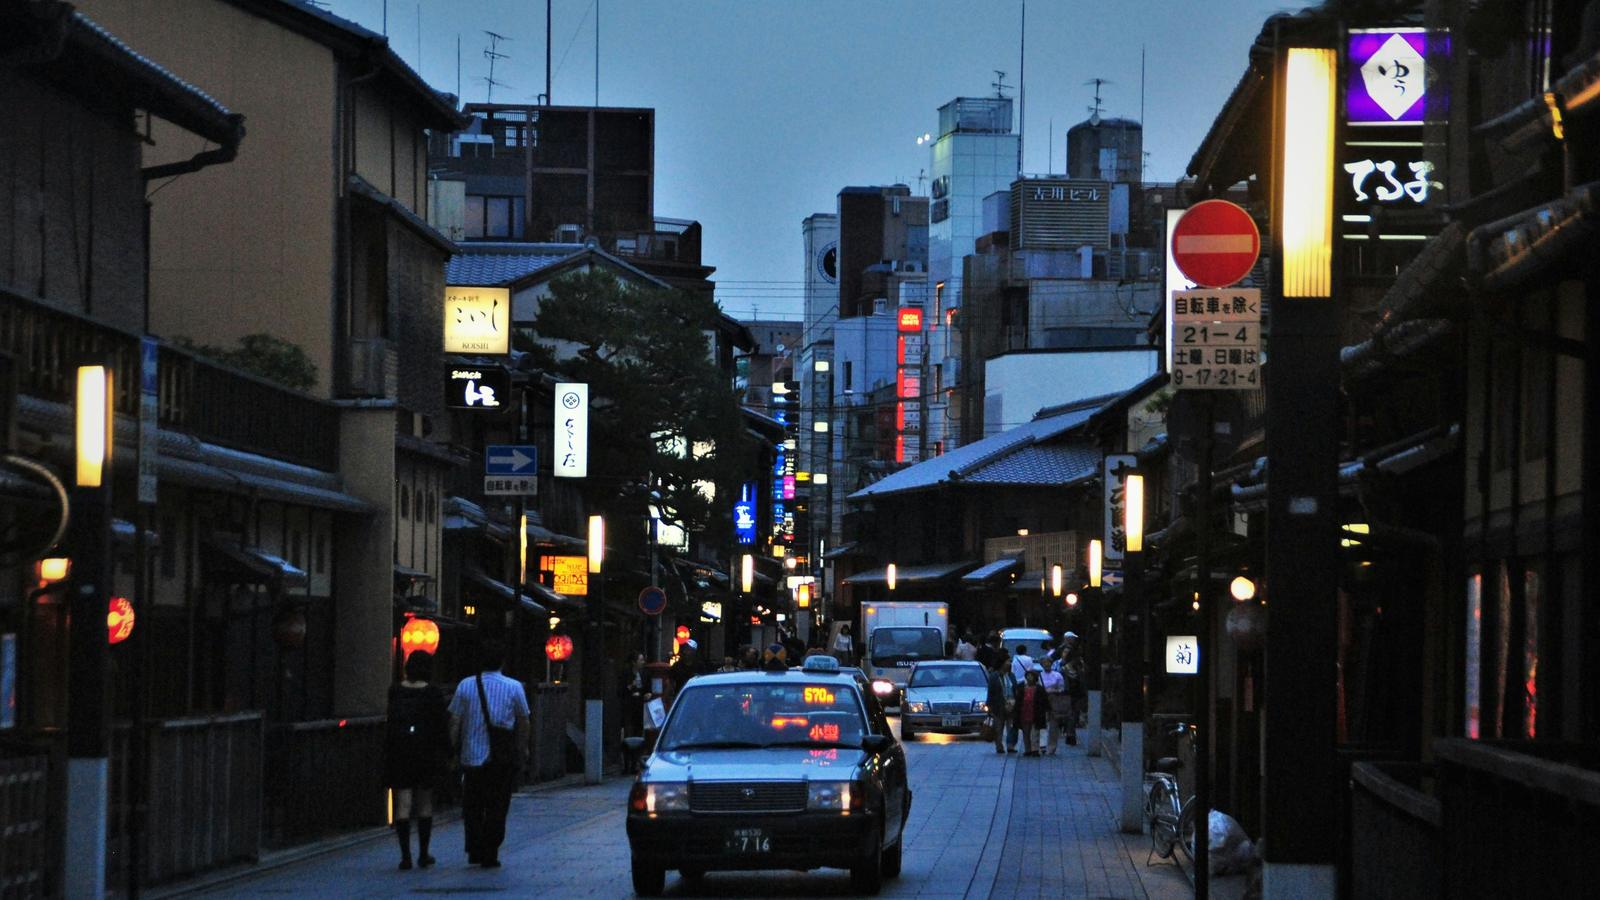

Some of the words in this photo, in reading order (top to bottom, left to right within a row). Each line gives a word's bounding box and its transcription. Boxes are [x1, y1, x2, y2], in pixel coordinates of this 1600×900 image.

[457, 298, 499, 332] こいし
[1175, 296, 1257, 315] 自転車を除く
[896, 660, 919, 668] ISUZ
